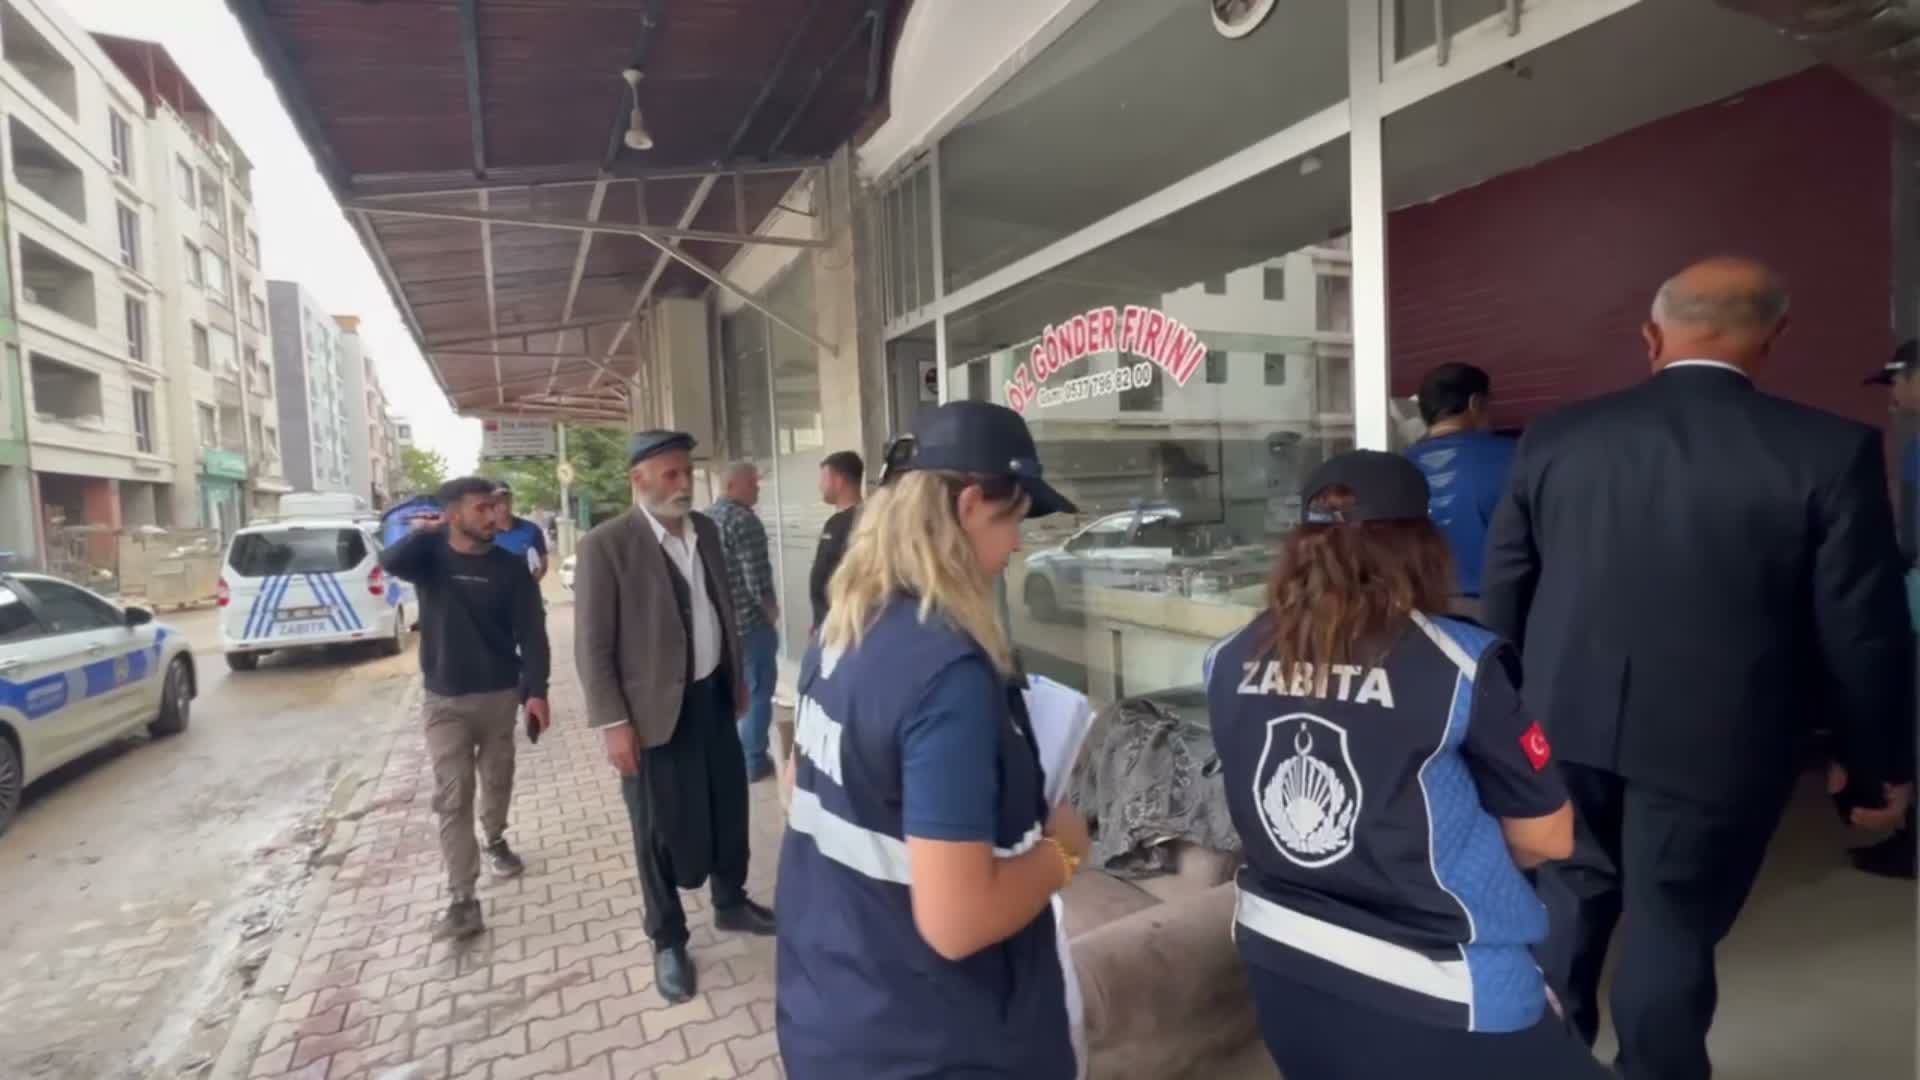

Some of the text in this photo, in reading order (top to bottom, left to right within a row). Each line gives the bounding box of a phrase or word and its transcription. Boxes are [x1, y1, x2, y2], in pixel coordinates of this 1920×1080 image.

[1031, 307, 1116, 381] GÖNDER
[1120, 306, 1207, 386] FIRINI
[1133, 362, 1152, 388] 00
[1236, 660, 1395, 708] ZABITA
